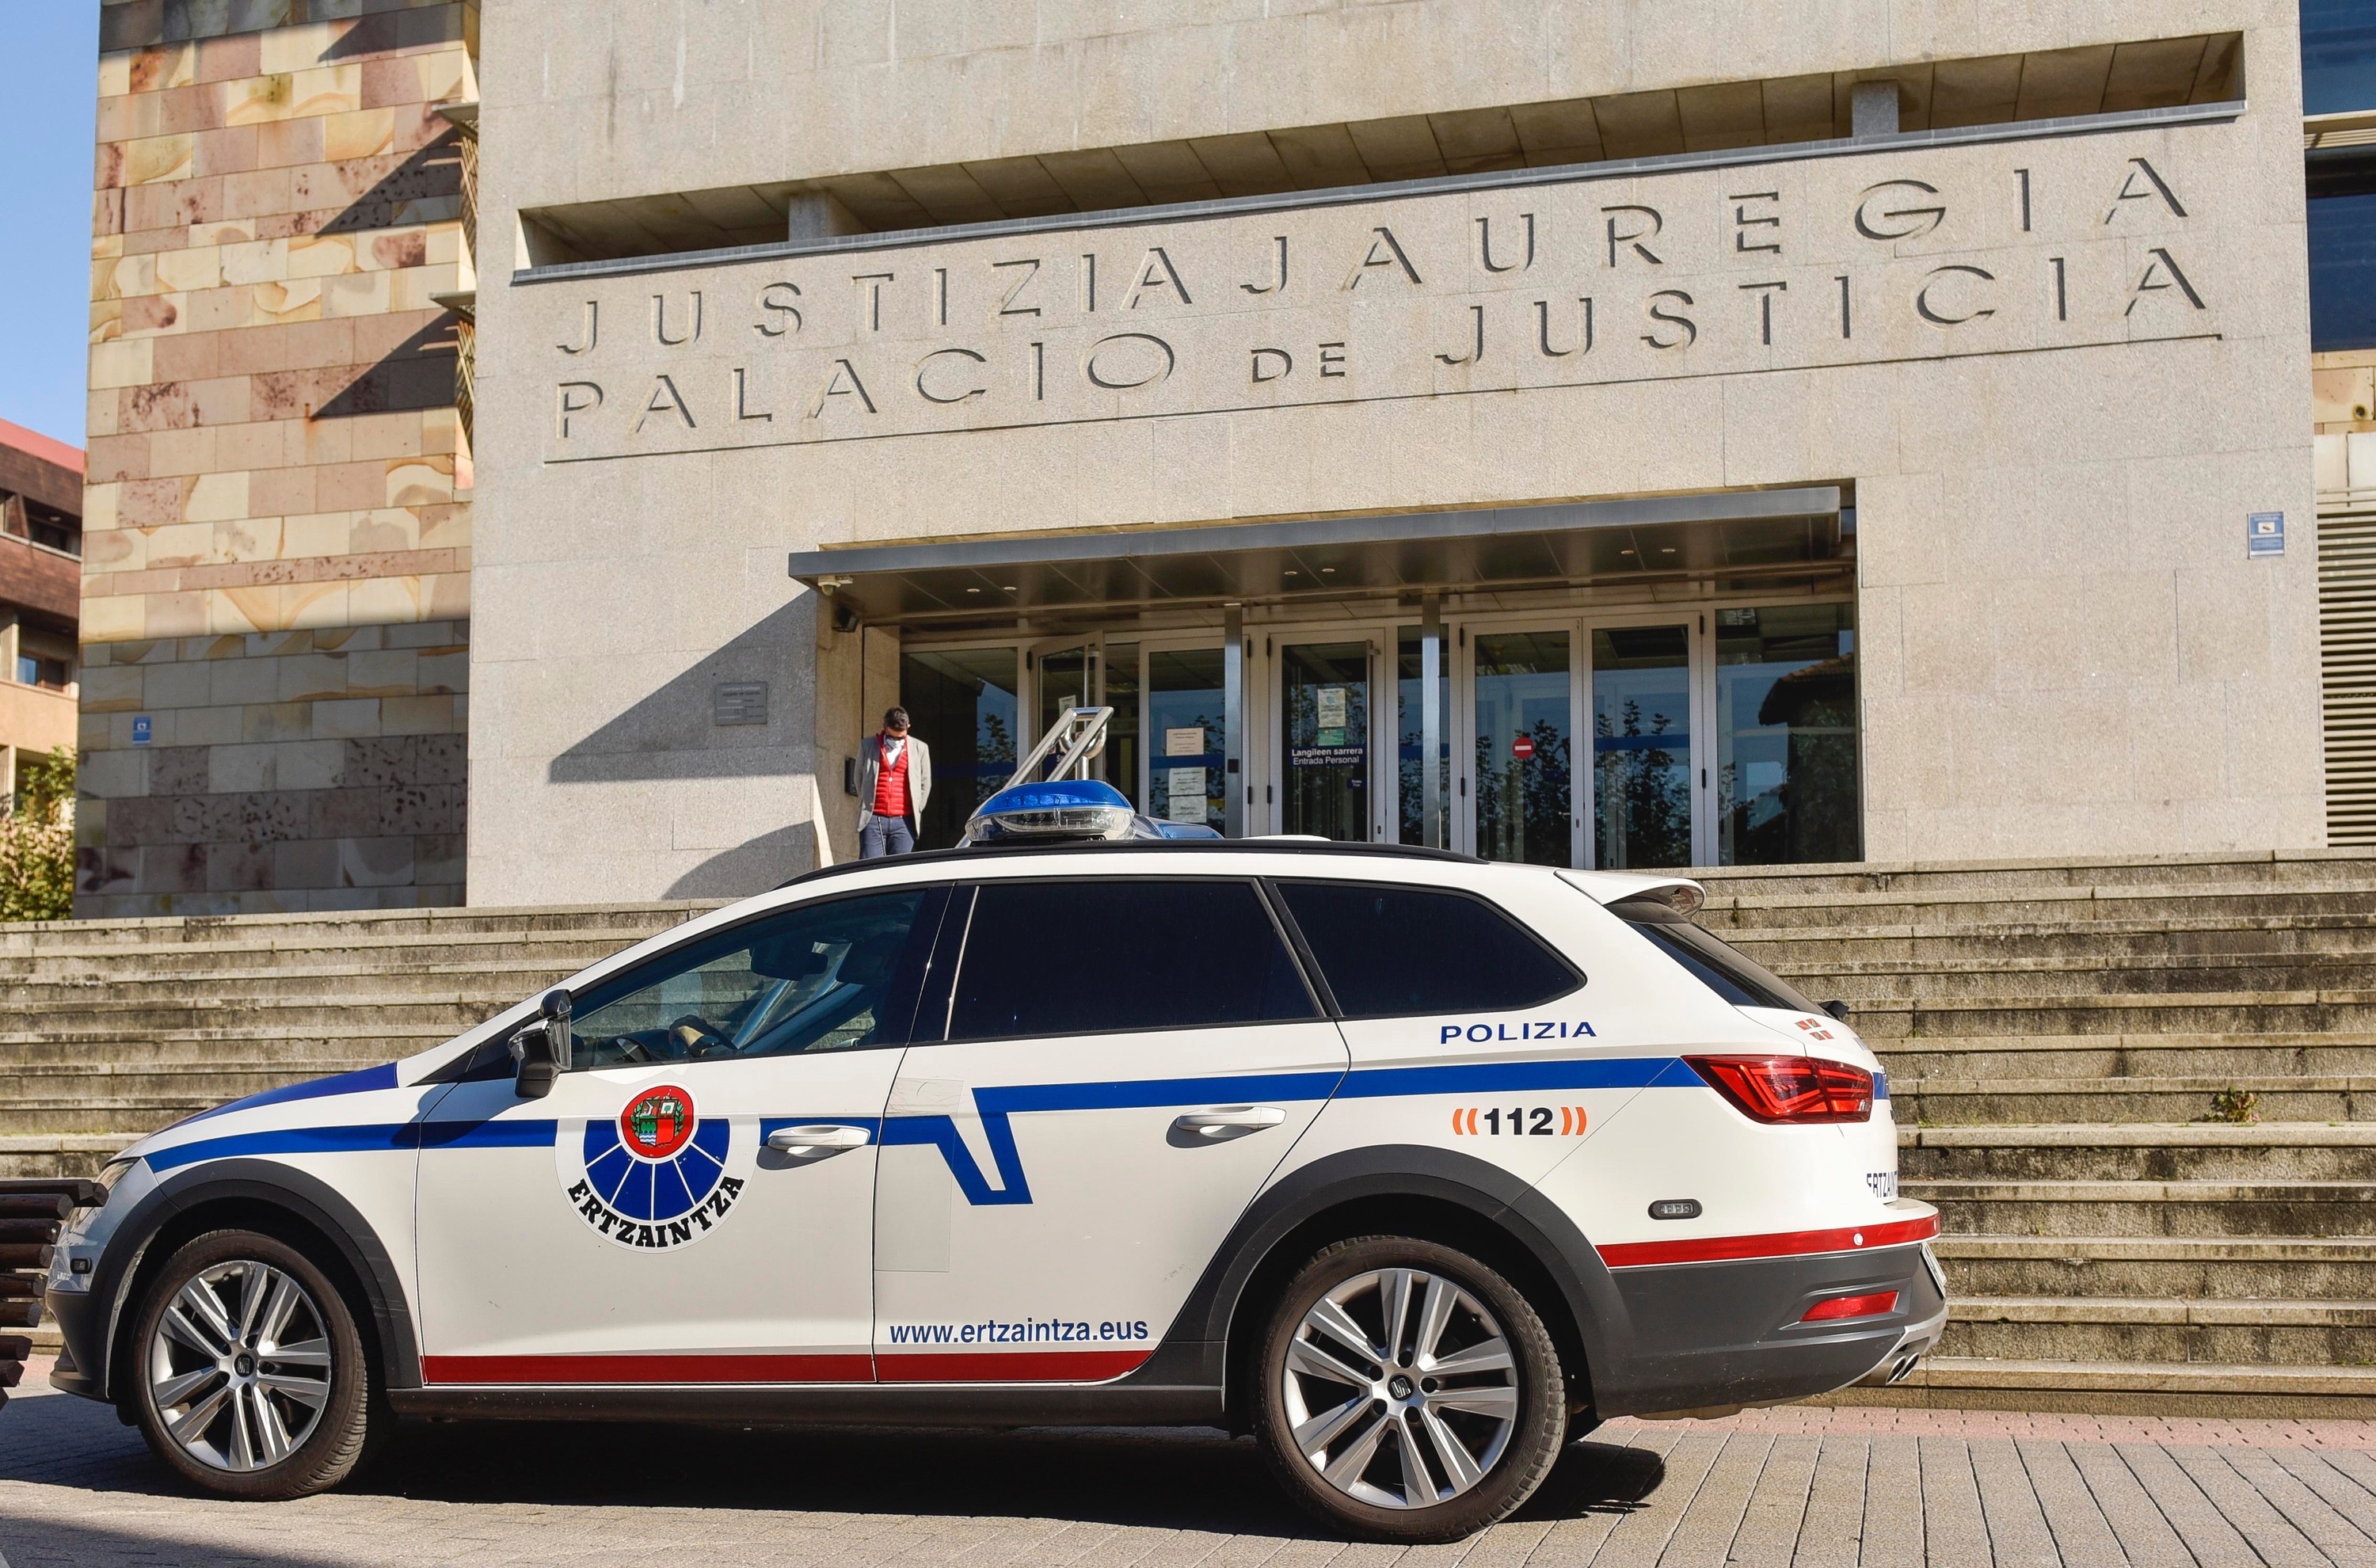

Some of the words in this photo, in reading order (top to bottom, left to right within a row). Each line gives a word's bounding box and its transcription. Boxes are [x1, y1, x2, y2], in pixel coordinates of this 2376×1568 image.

[556, 246, 1193, 355] JUSTIZIA
[1239, 157, 2188, 295] JAUREGIA
[555, 333, 1175, 440] PALACIO
[1251, 341, 1346, 383] DE
[1434, 247, 2207, 366] JUSTICIA
[1291, 748, 1332, 758] Langileen
[1293, 756, 1324, 766] Entrada
[1324, 755, 1360, 764] Personal
[1440, 1021, 1597, 1045] POLIZIA
[567, 1175, 745, 1248] ERTZAINTZA
[889, 1317, 1149, 1344] www.ertzaintza.eus
